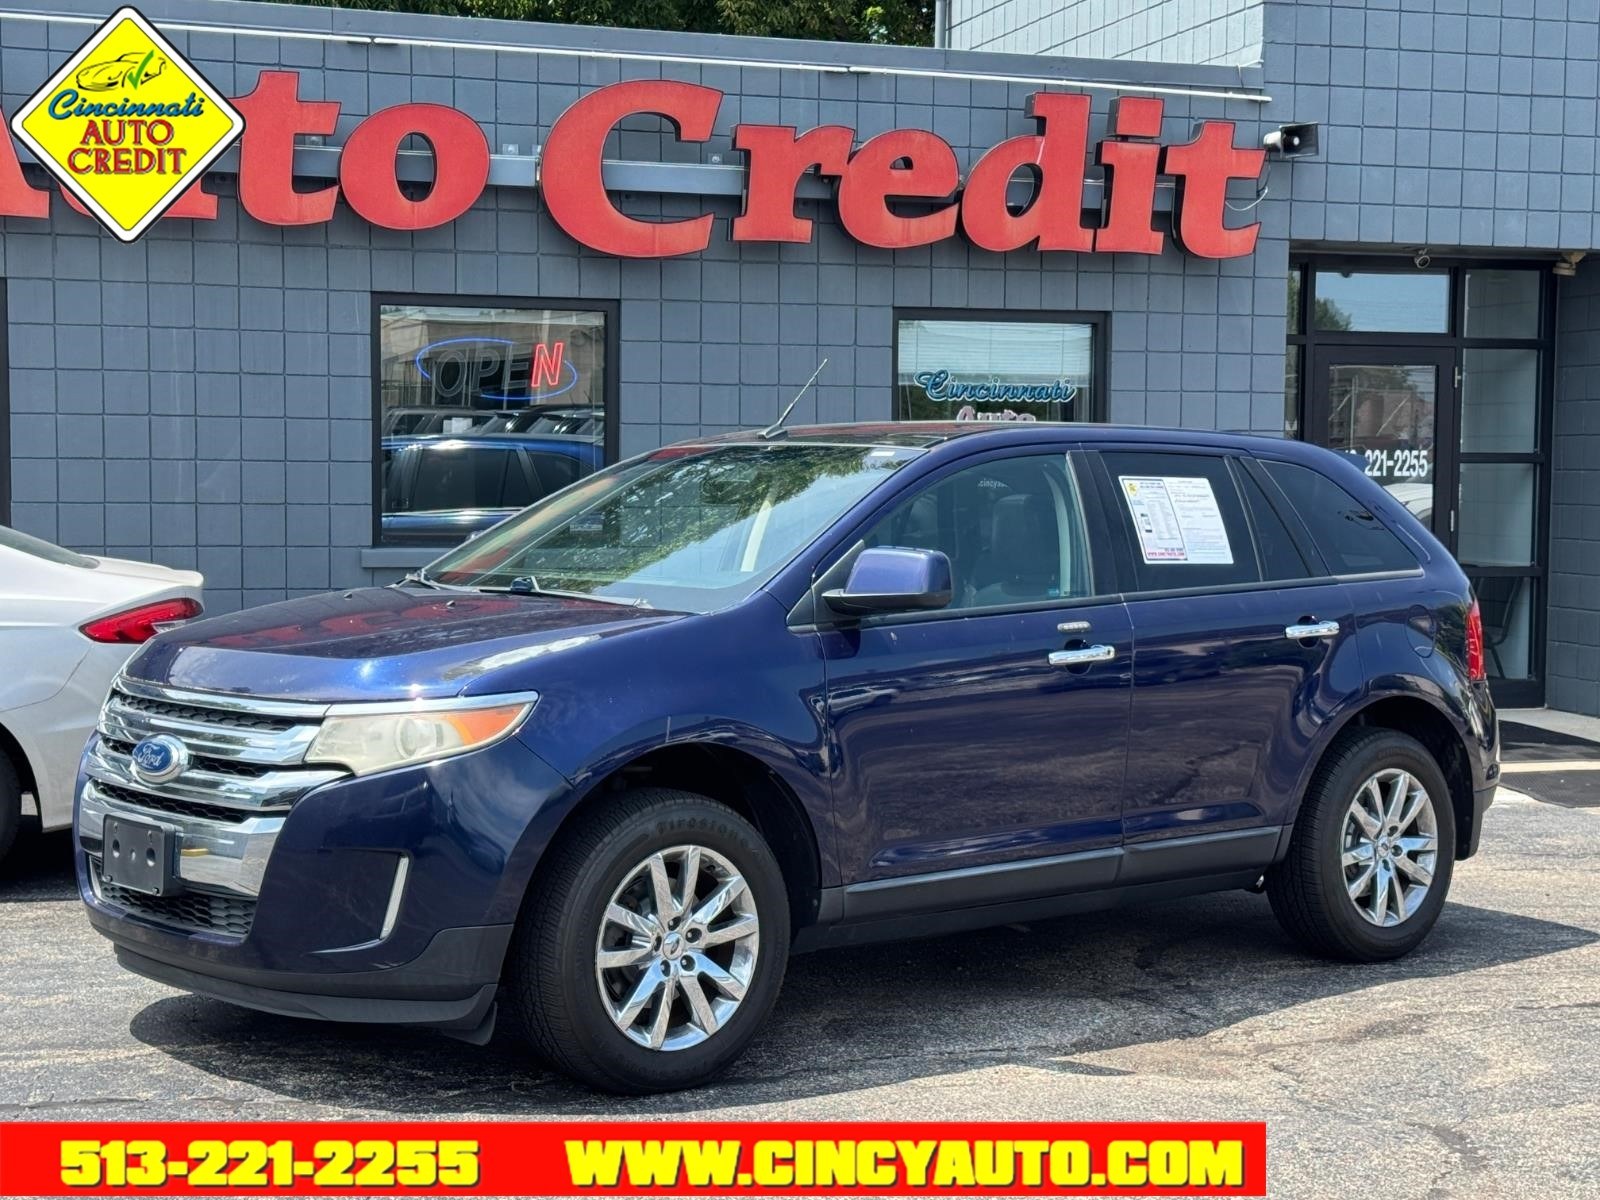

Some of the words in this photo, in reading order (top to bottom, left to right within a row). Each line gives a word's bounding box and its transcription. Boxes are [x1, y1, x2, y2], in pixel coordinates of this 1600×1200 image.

[0, 71, 490, 229] to
[537, 78, 1266, 260] Credit
[436, 342, 565, 397] OPEN
[914, 368, 1077, 403] Cincinnati
[137, 743, 165, 768] Ford
